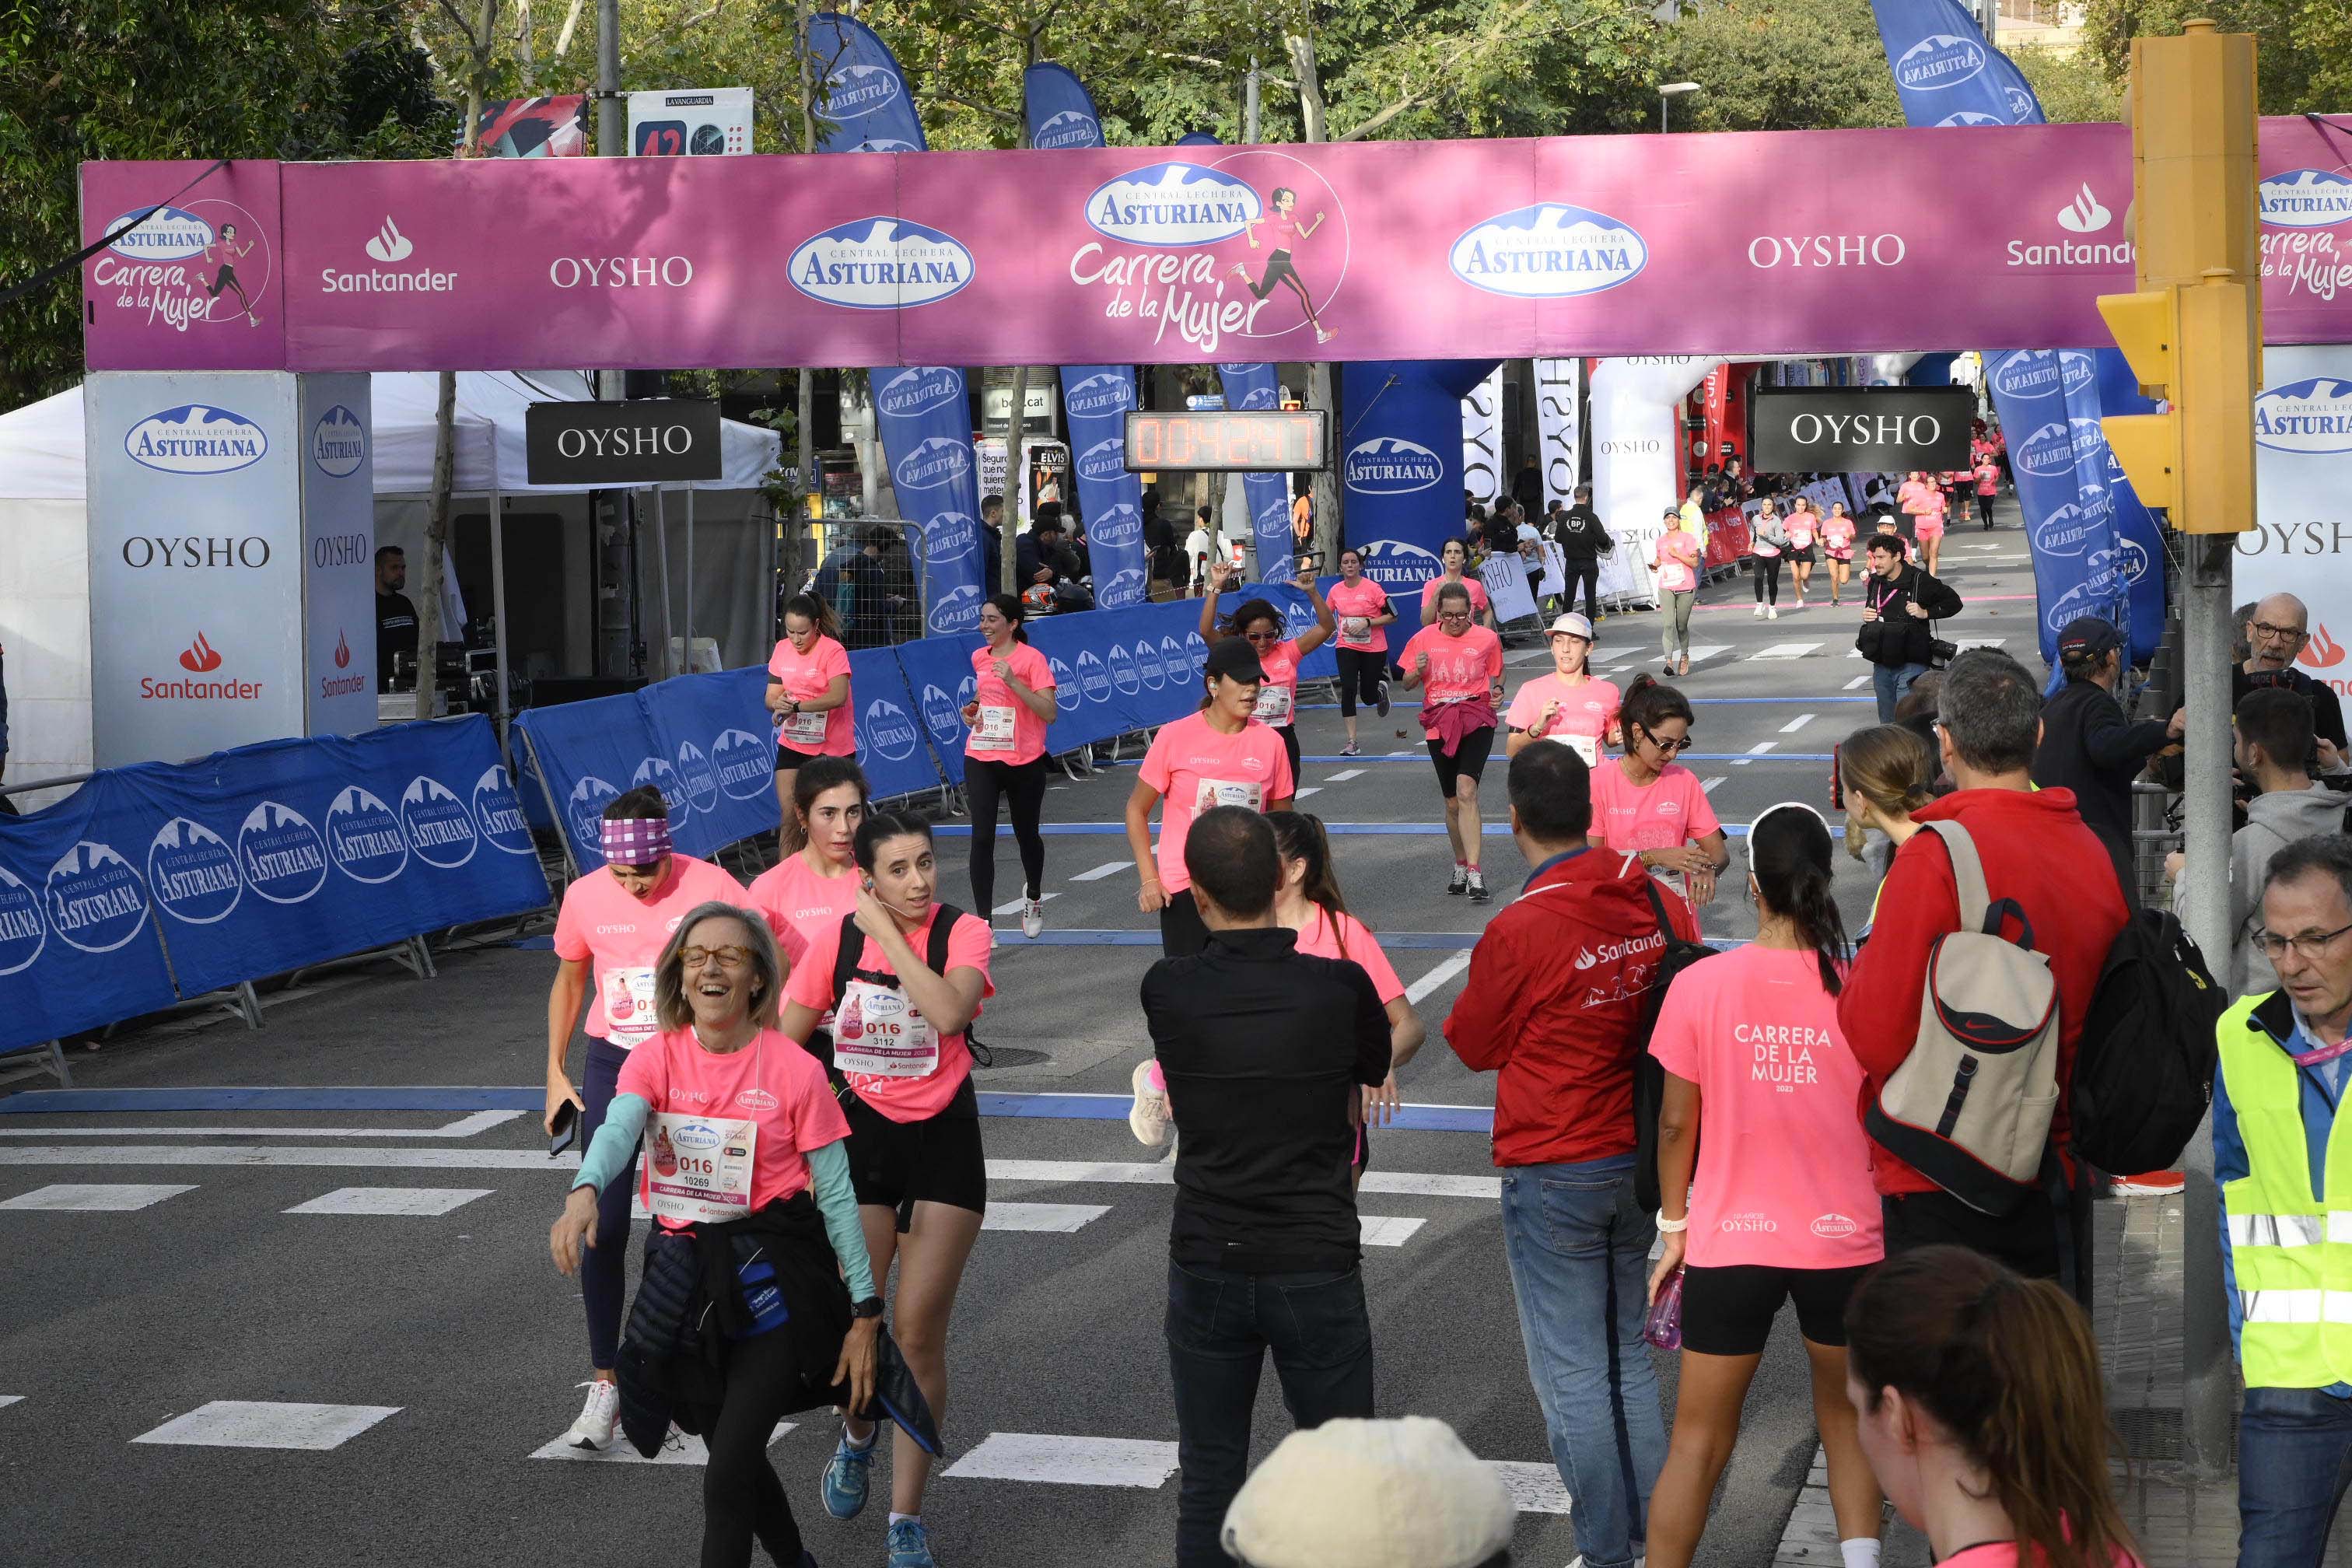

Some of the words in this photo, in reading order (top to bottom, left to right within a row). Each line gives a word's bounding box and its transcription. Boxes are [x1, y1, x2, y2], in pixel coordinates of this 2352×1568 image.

[1125, 191, 1182, 199] CENTRAL
[1187, 189, 1243, 198] LECHERA
[1098, 194, 1247, 226] ASTURIANA
[1495, 235, 1555, 244] CENTRAL
[1563, 234, 1626, 243] LECHERA
[2260, 232, 2334, 254] arrera
[831, 248, 888, 257] CENTRAL
[896, 247, 954, 257] LECHERA
[1465, 239, 1633, 275] ASTURIANA
[1748, 233, 1906, 268] OYSHO
[2007, 240, 2135, 266] Santand
[94, 257, 186, 285] Carrera
[549, 255, 694, 289] OYSHO
[801, 251, 960, 285] ASTURIANA
[1070, 243, 1213, 285] Carrera
[2279, 256, 2291, 276] la
[322, 268, 458, 292] Santander
[2289, 250, 2352, 300] Muje
[117, 289, 134, 308] de
[137, 288, 149, 307] la
[147, 278, 220, 331] Mujer
[1105, 291, 1132, 317] de
[1138, 290, 1157, 317] la
[1154, 282, 1270, 353] Mujer
[2277, 404, 2330, 412] CENTRAL
[1790, 414, 1941, 446] OYSHO
[135, 429, 258, 457] ASTURIANA
[317, 433, 362, 459] ASTURIANA
[558, 425, 692, 457] OYSHO
[1601, 439, 1660, 455] OYSHO
[1041, 453, 1065, 463] ELVIS
[1347, 460, 1435, 481] ASTURIANA
[2234, 522, 2352, 556] OYSH
[123, 536, 271, 568] OYSHO
[315, 534, 366, 568] OYSHO
[1365, 568, 1435, 583] TURIANA
[140, 676, 262, 698] Santander
[321, 672, 366, 698] Santander
[718, 755, 772, 786] ASTURIANA
[415, 809, 438, 819] CENTRAL
[439, 805, 461, 816] LECHERA
[341, 817, 365, 830] CENTRAL
[366, 816, 392, 828] LECHERA
[408, 812, 474, 849] ASTURIANA
[254, 835, 282, 849] CENTRAL
[283, 831, 311, 844] LECHERA
[331, 824, 404, 863] ASTURIANA
[166, 854, 196, 867] CENTRAL
[197, 849, 226, 862] LECHERA
[246, 841, 324, 883] ASTURIANA
[156, 861, 237, 903] ASTURIANA
[796, 906, 832, 919] OYSHO
[597, 923, 635, 934] OYSHO
[866, 1001, 901, 1011] ASTURIANA
[866, 1022, 901, 1035] 016
[1734, 1024, 1832, 1048] CARRERA
[873, 1037, 894, 1046] 3112
[844, 1057, 874, 1068] OYSHO
[1755, 1045, 1780, 1062] DE
[1788, 1048, 1814, 1065] LA
[1752, 1064, 1818, 1083] MUJER
[738, 1095, 775, 1108] ASTURIANA
[675, 1132, 716, 1146] ASTURIANA
[680, 1157, 712, 1174] 016
[659, 1186, 685, 1195] CARRERA
[684, 1175, 709, 1188] 10269
[657, 1199, 684, 1211] OYSHO
[1722, 1220, 1776, 1232] OYSHO
[1815, 1222, 1853, 1232] ASTURIANA
